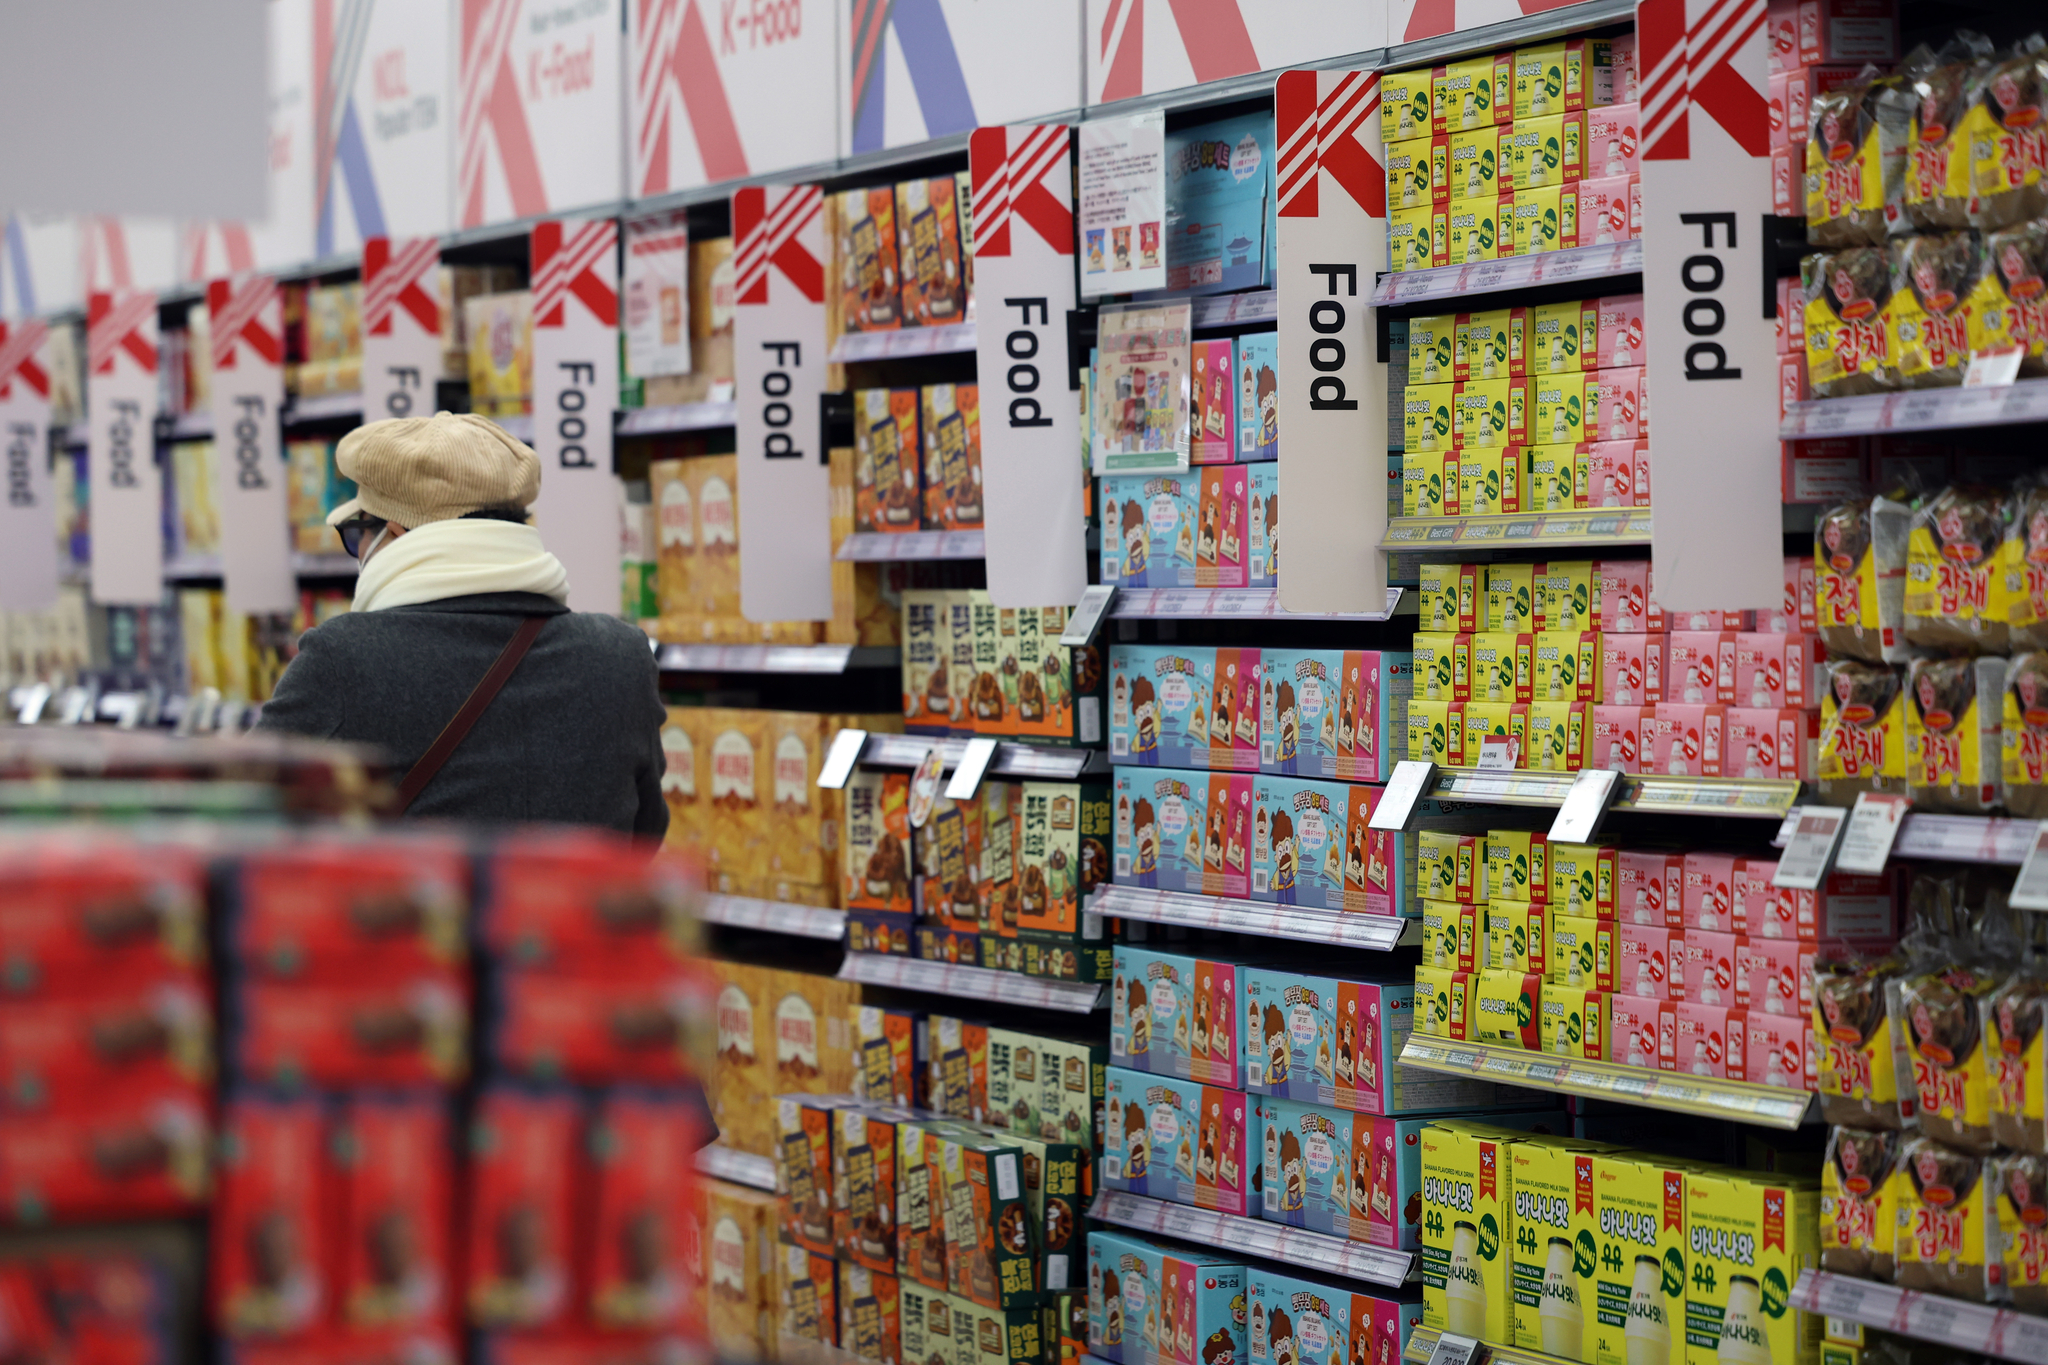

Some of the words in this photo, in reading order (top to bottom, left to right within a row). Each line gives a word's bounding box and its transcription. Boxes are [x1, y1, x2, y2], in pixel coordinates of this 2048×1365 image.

[528, 33, 595, 101] K-Food
[1517, 61, 1542, 78] 바나나맛
[1382, 87, 1408, 102] 바나나맛
[1447, 75, 1471, 91] 바나나맛
[1453, 145, 1476, 160] 바나나맛
[1514, 132, 1539, 148] 바나나맛
[1824, 161, 1862, 219] 잡채
[1452, 213, 1475, 228] 바나나맛
[1680, 212, 1742, 381] Food
[1309, 264, 1358, 411] Food
[1411, 331, 1433, 345] 바나나맛
[1471, 326, 1491, 340] 바나나맛
[1835, 319, 1888, 375] 잡채
[1921, 311, 1969, 369] 잡채
[1005, 297, 1053, 429] Food
[762, 342, 803, 460] Food
[1465, 395, 1487, 409] 바나나맛
[1539, 389, 1561, 403] 바나나맛
[557, 362, 595, 469] Food
[109, 401, 141, 489] Food
[235, 396, 268, 491] Food
[6, 422, 37, 506] Food
[1430, 528, 1441, 538] Best
[1441, 526, 1455, 538] Gift
[1421, 577, 1441, 593] 바나나맛
[1490, 577, 1512, 592] 바나나맛
[1936, 565, 1988, 615] 잡채
[1476, 648, 1496, 662] 바나나맛
[1537, 647, 1559, 661] 바나나맛
[1835, 725, 1883, 778] 잡채
[1921, 730, 1961, 786] 잡채
[1419, 846, 1439, 861] 바나나맛
[1489, 846, 1510, 860] 바나나맛
[1490, 916, 1510, 930] 바나나맛
[1543, 1002, 1564, 1016] 바나나맛
[1830, 1044, 1872, 1097] 잡채
[1915, 1061, 1965, 1115] 잡채
[1424, 1164, 1437, 1172] BANANA
[1438, 1166, 1454, 1175] FLAVORED
[1424, 1176, 1473, 1213] 바나나맛
[1516, 1178, 1531, 1186] BANANA
[1531, 1180, 1549, 1189] FLAVORED
[1550, 1183, 1558, 1191] MILK
[1559, 1185, 1570, 1193] DRINK
[1425, 1209, 1445, 1238] 우유
[1515, 1191, 1569, 1229] 바나나맛
[1836, 1196, 1877, 1249] 잡채
[1517, 1225, 1537, 1255] 우유
[1600, 1207, 1657, 1248] 바나나맛
[1916, 1206, 1963, 1263] 잡채
[1601, 1243, 1624, 1274] 우유
[1690, 1224, 1755, 1267] 바나나맛
[1691, 1262, 1717, 1294] 우유
